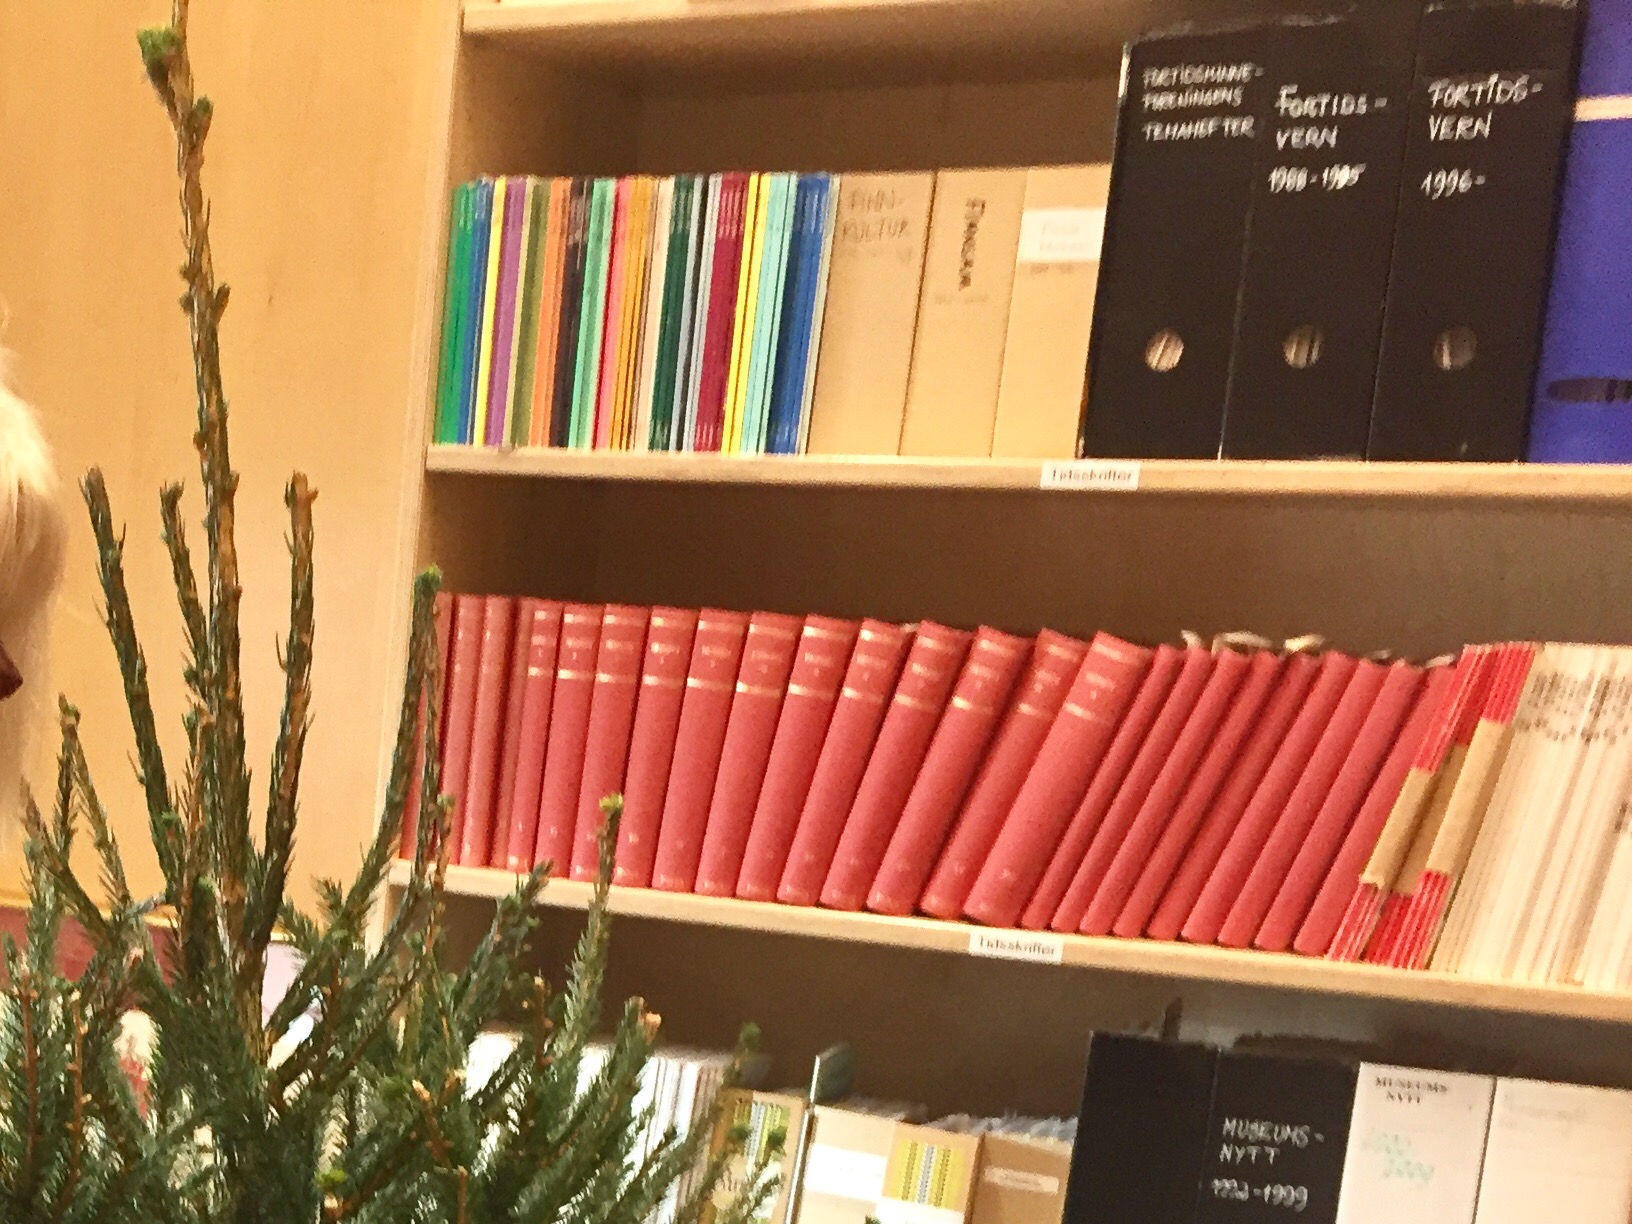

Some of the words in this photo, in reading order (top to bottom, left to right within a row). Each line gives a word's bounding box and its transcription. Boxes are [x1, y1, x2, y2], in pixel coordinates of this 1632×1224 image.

[1277, 125, 1338, 151] VERN
[1428, 109, 1492, 142] VERN
[1219, 1143, 1281, 1166] NYTT
